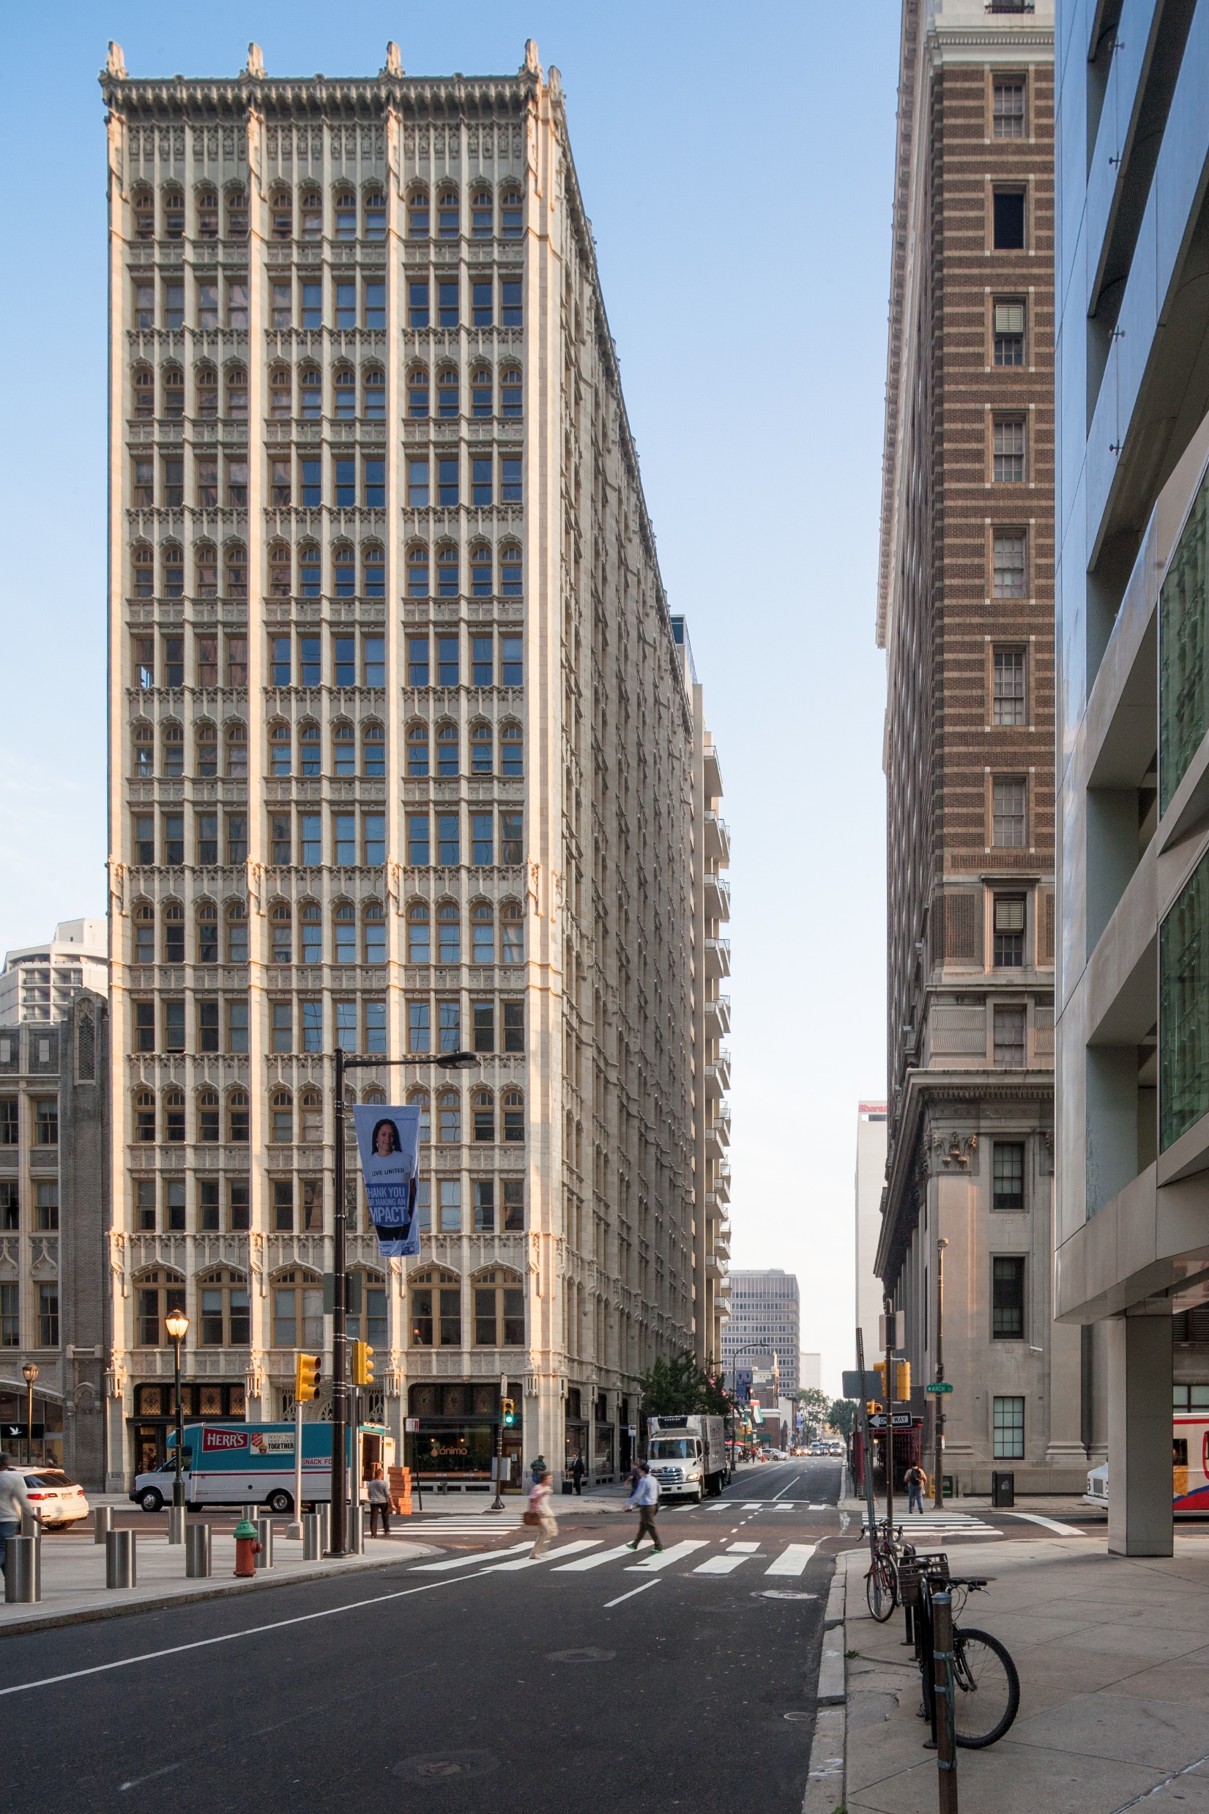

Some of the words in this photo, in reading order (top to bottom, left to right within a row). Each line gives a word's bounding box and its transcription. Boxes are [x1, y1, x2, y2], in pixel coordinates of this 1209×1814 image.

[388, 1187, 405, 1198] YOU
[376, 1198, 396, 1206] MAKING
[370, 1207, 406, 1222] MPACT
[207, 1433, 244, 1446] HERR'S
[440, 1446, 468, 1455] ánimo
